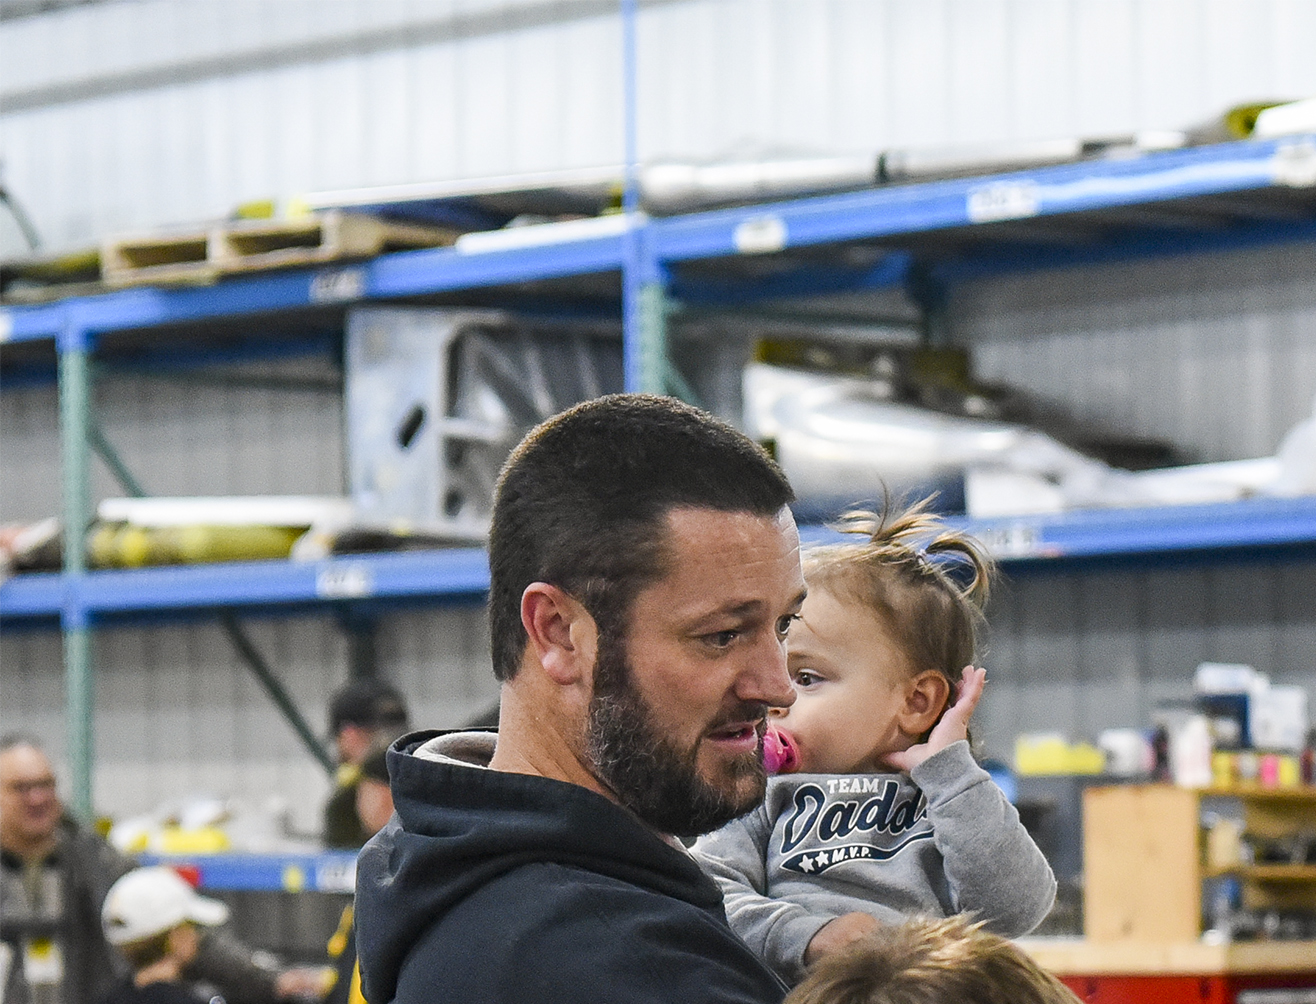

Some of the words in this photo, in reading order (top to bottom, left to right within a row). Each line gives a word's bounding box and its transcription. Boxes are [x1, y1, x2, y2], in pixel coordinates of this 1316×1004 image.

[827, 778, 879, 794] TEAM
[780, 779, 928, 854] Dadd
[831, 846, 871, 864] M.V.P.
